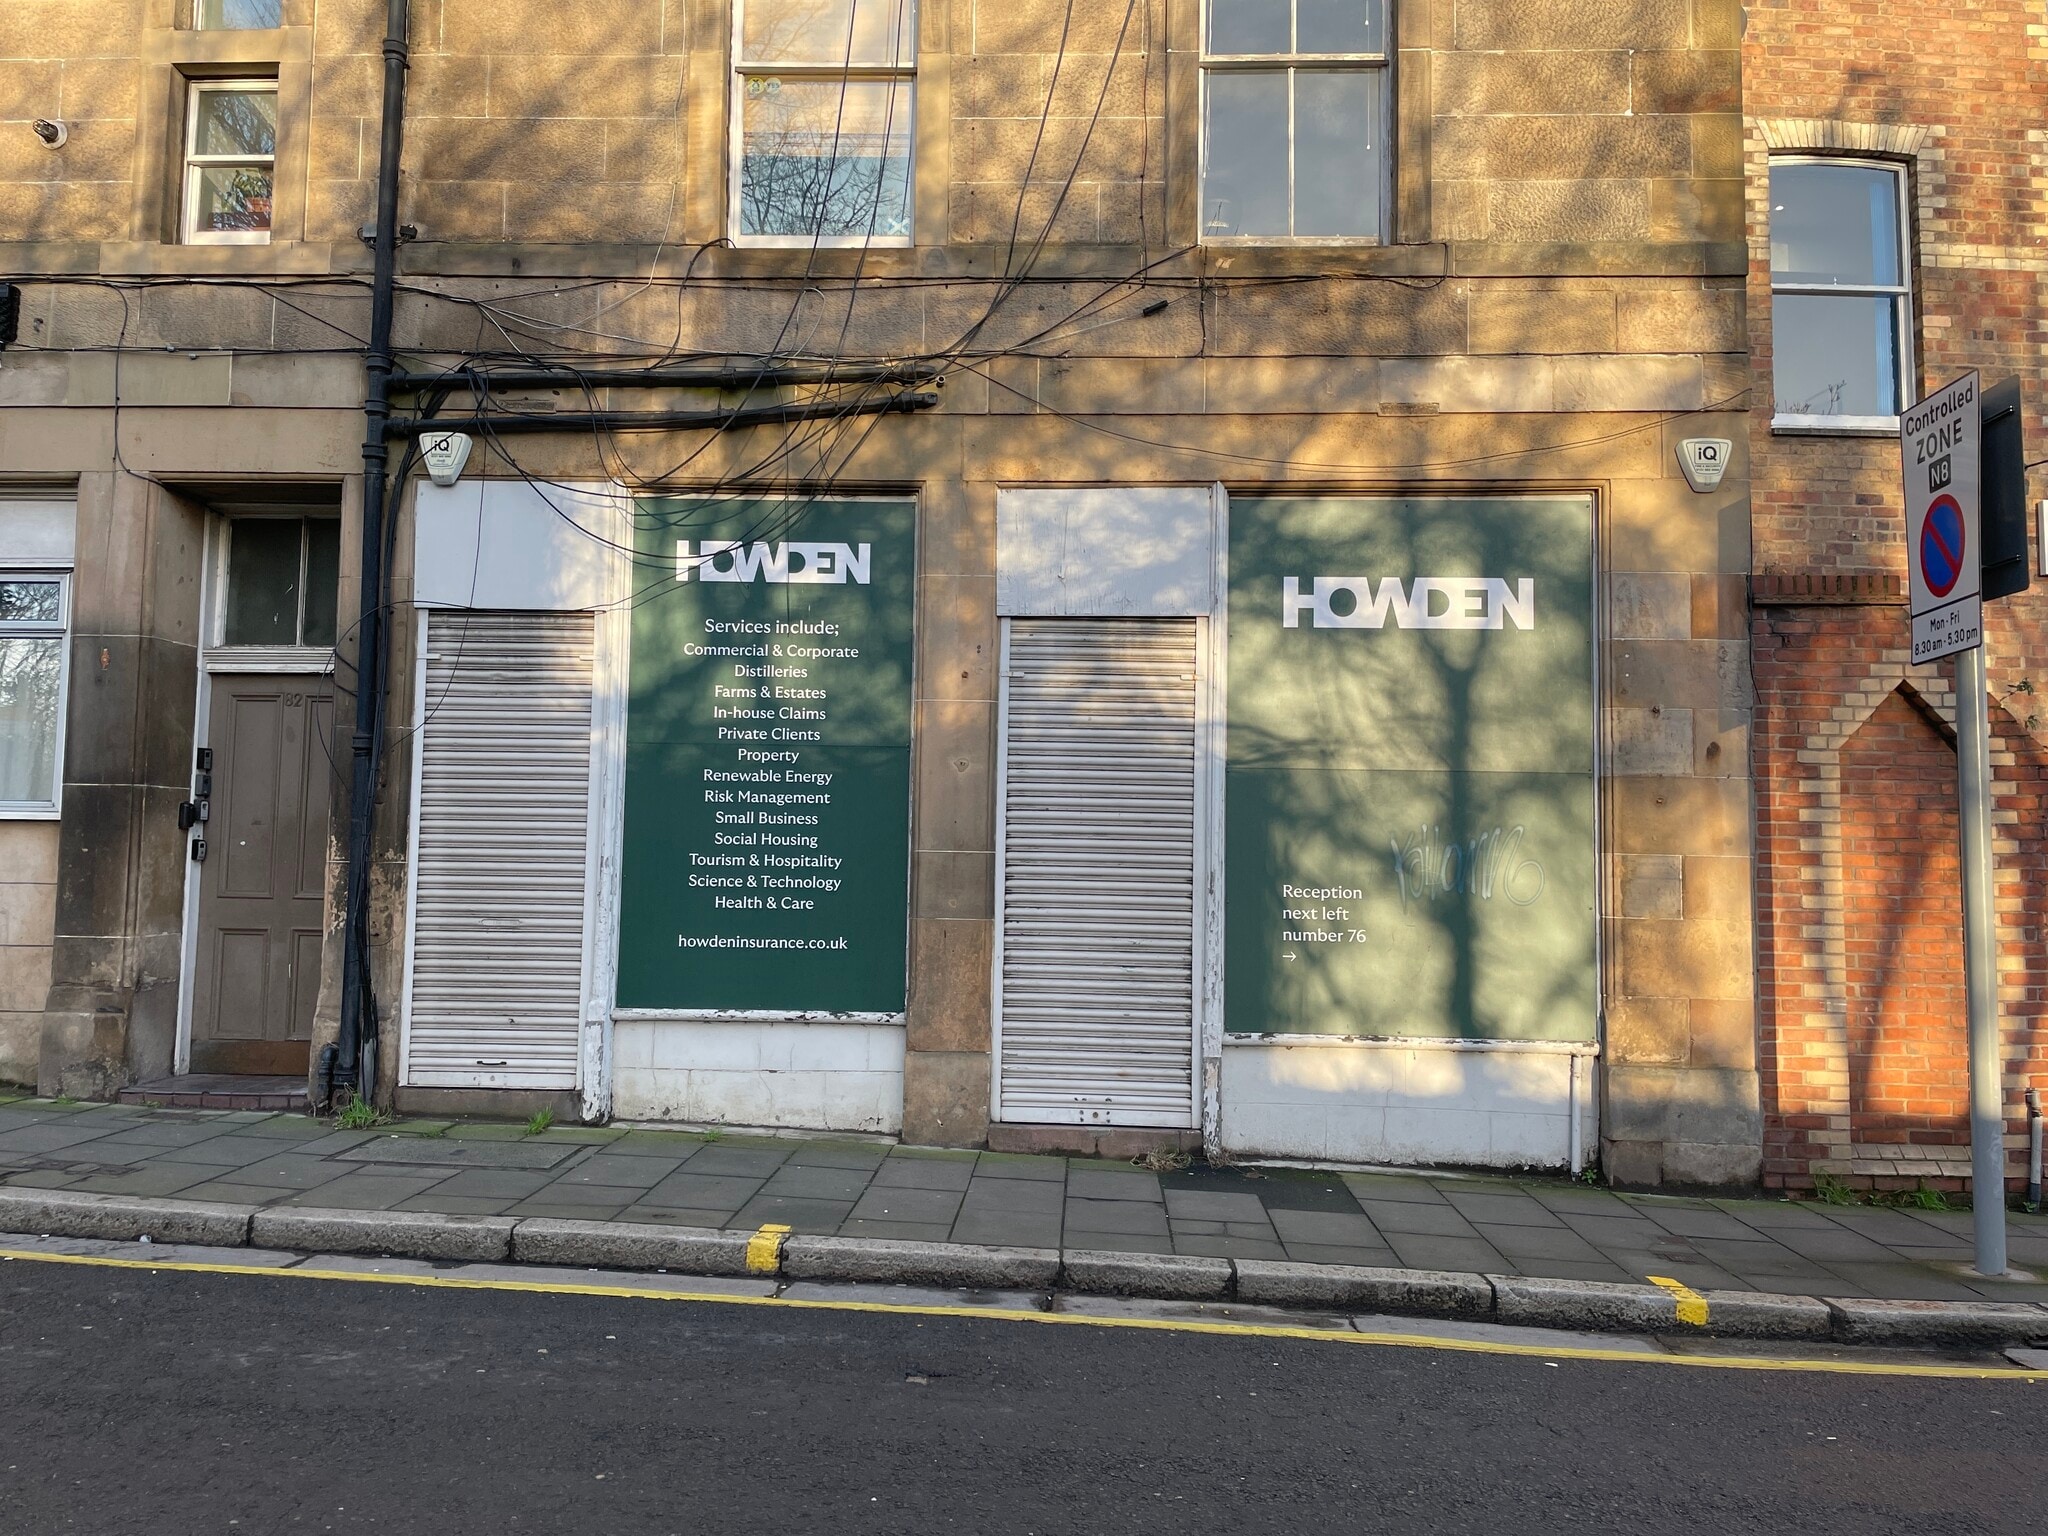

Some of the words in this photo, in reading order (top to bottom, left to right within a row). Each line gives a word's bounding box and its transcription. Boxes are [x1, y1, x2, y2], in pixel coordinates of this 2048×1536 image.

[1906, 381, 1973, 437] Controlled
[434, 439, 450, 452] iQ
[1916, 417, 1963, 465] ZONE
[1698, 446, 1717, 461] iQ
[1931, 460, 1949, 488] N8
[675, 539, 871, 585] HOWDEN
[1282, 575, 1535, 630] HOWDEN
[704, 618, 771, 634] Services
[775, 619, 840, 637] include;
[1930, 618, 1944, 632] Mon
[1950, 610, 1960, 626] Fri
[1914, 639, 1931, 656] 8.30
[1932, 639, 1943, 651] am
[1947, 628, 1965, 646] 5.30
[1966, 627, 1978, 643] pm
[683, 642, 769, 657] Commercial
[772, 644, 783, 657] &
[786, 644, 859, 660] Corporate
[734, 664, 808, 678] Distilleries
[285, 692, 303, 707] 82
[714, 684, 757, 698] Farms
[760, 685, 771, 699] &
[774, 686, 827, 700] Estates
[713, 705, 775, 719] In-house
[778, 706, 826, 720] Claims
[718, 727, 768, 740] Private
[771, 728, 821, 741] Clients
[737, 748, 800, 764] Property
[703, 768, 782, 783] Renewable
[785, 770, 833, 786] Energy
[704, 789, 734, 803] Risk
[737, 791, 831, 807] Management
[715, 810, 754, 824] Small
[758, 811, 819, 825] Business
[714, 831, 757, 845] Social
[761, 832, 819, 849] Housing
[689, 853, 746, 867] Tourism
[749, 854, 760, 867] &
[763, 854, 842, 871] Hospitality
[688, 874, 743, 888] Science
[746, 875, 758, 888] &
[761, 875, 842, 892] Technology
[1282, 884, 1363, 902] Reception
[714, 895, 763, 909] Health
[766, 896, 777, 909] &
[781, 897, 815, 910] Care
[1282, 908, 1319, 920] next
[1322, 906, 1350, 921] left
[678, 933, 848, 950] howdeninsurance.co.uk
[1282, 927, 1344, 942] number
[1347, 929, 1367, 943] 76
